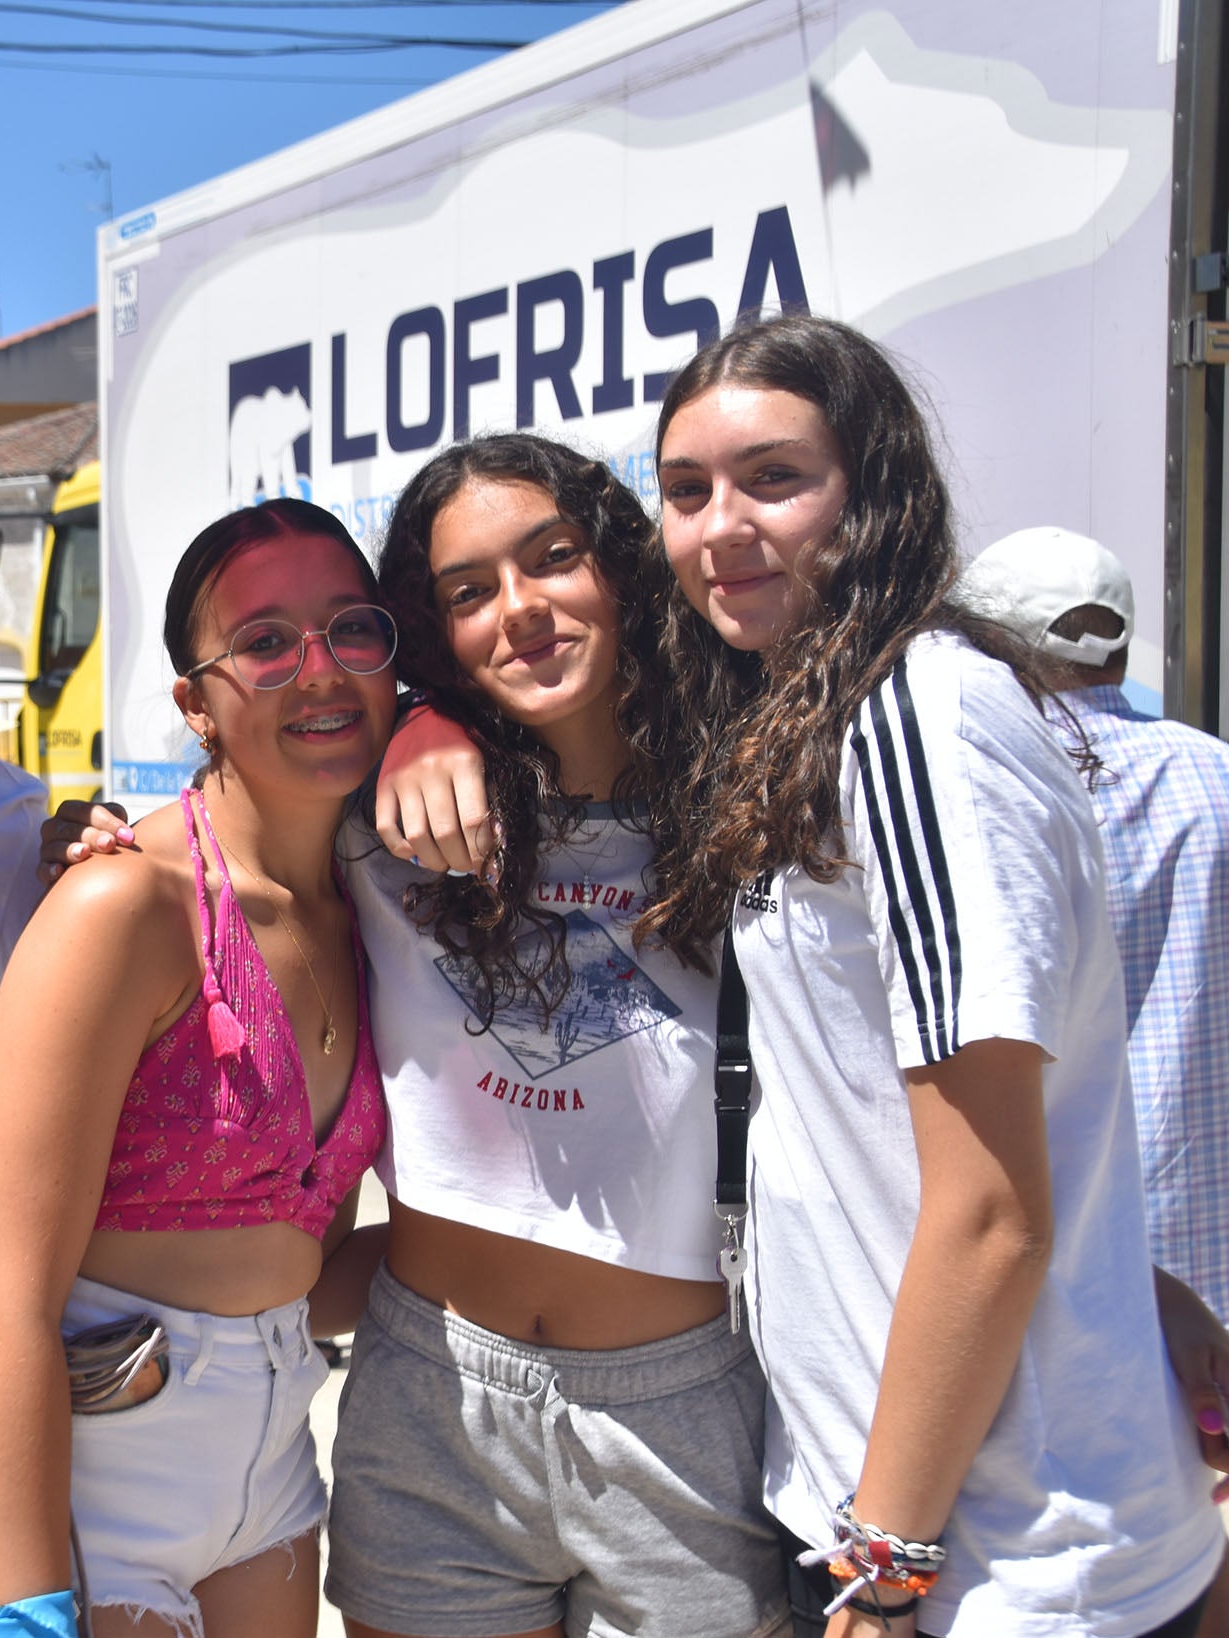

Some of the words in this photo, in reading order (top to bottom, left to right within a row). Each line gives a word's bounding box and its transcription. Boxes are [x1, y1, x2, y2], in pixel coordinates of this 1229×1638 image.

[331, 205, 812, 464] LOFRISA
[537, 881, 635, 911] CANYON
[476, 1069, 585, 1112] ARIZONA
